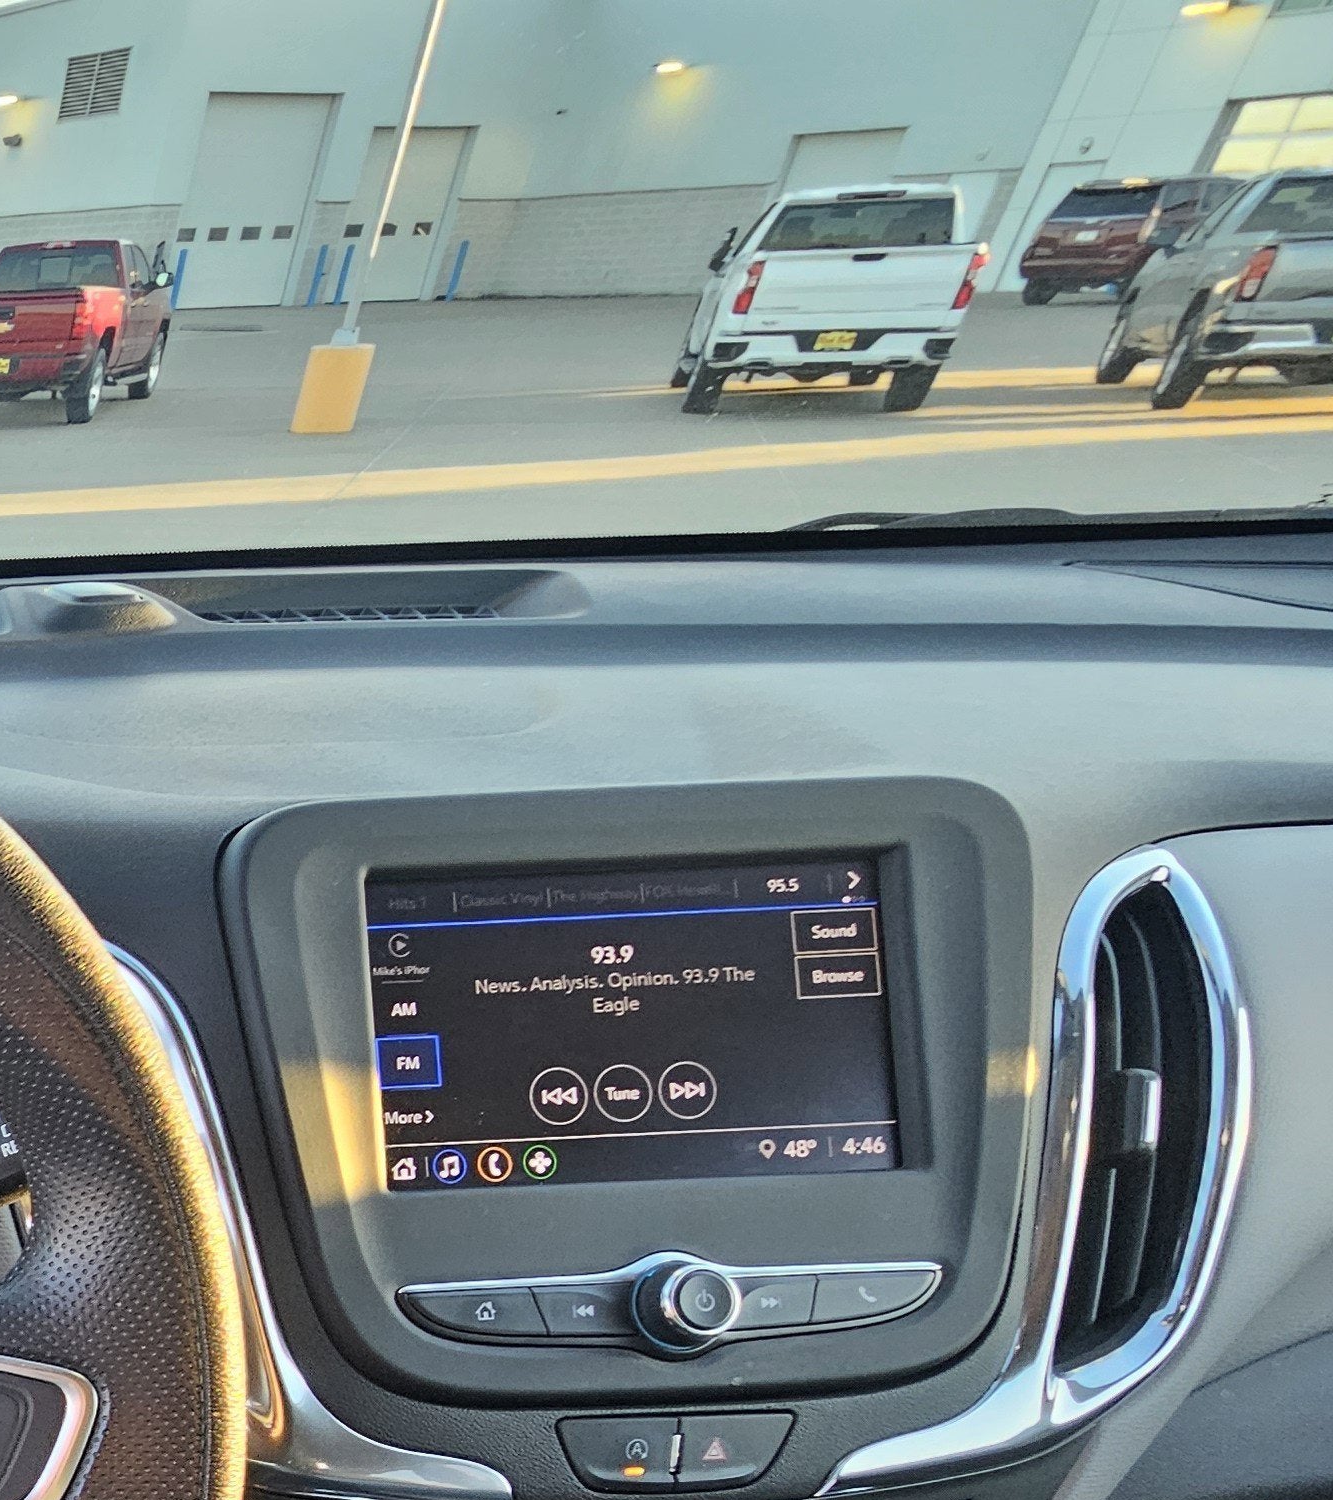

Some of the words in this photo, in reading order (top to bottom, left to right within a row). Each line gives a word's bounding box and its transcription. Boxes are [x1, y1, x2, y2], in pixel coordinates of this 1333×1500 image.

[766, 878, 800, 893] 95.5
[811, 922, 858, 939] Sound
[590, 944, 633, 964] 93.9
[474, 978, 527, 994] News.
[530, 974, 604, 995] Analysis.
[607, 971, 679, 992] Opinion.
[683, 968, 719, 984] 93.9
[723, 966, 756, 982] The
[812, 969, 865, 984] Browse
[391, 1002, 417, 1017] AM
[592, 997, 640, 1017] Eagle
[396, 1056, 421, 1070] FM
[604, 1086, 640, 1101] Tune
[384, 1110, 424, 1125] More
[842, 1136, 887, 1155] 4:46
